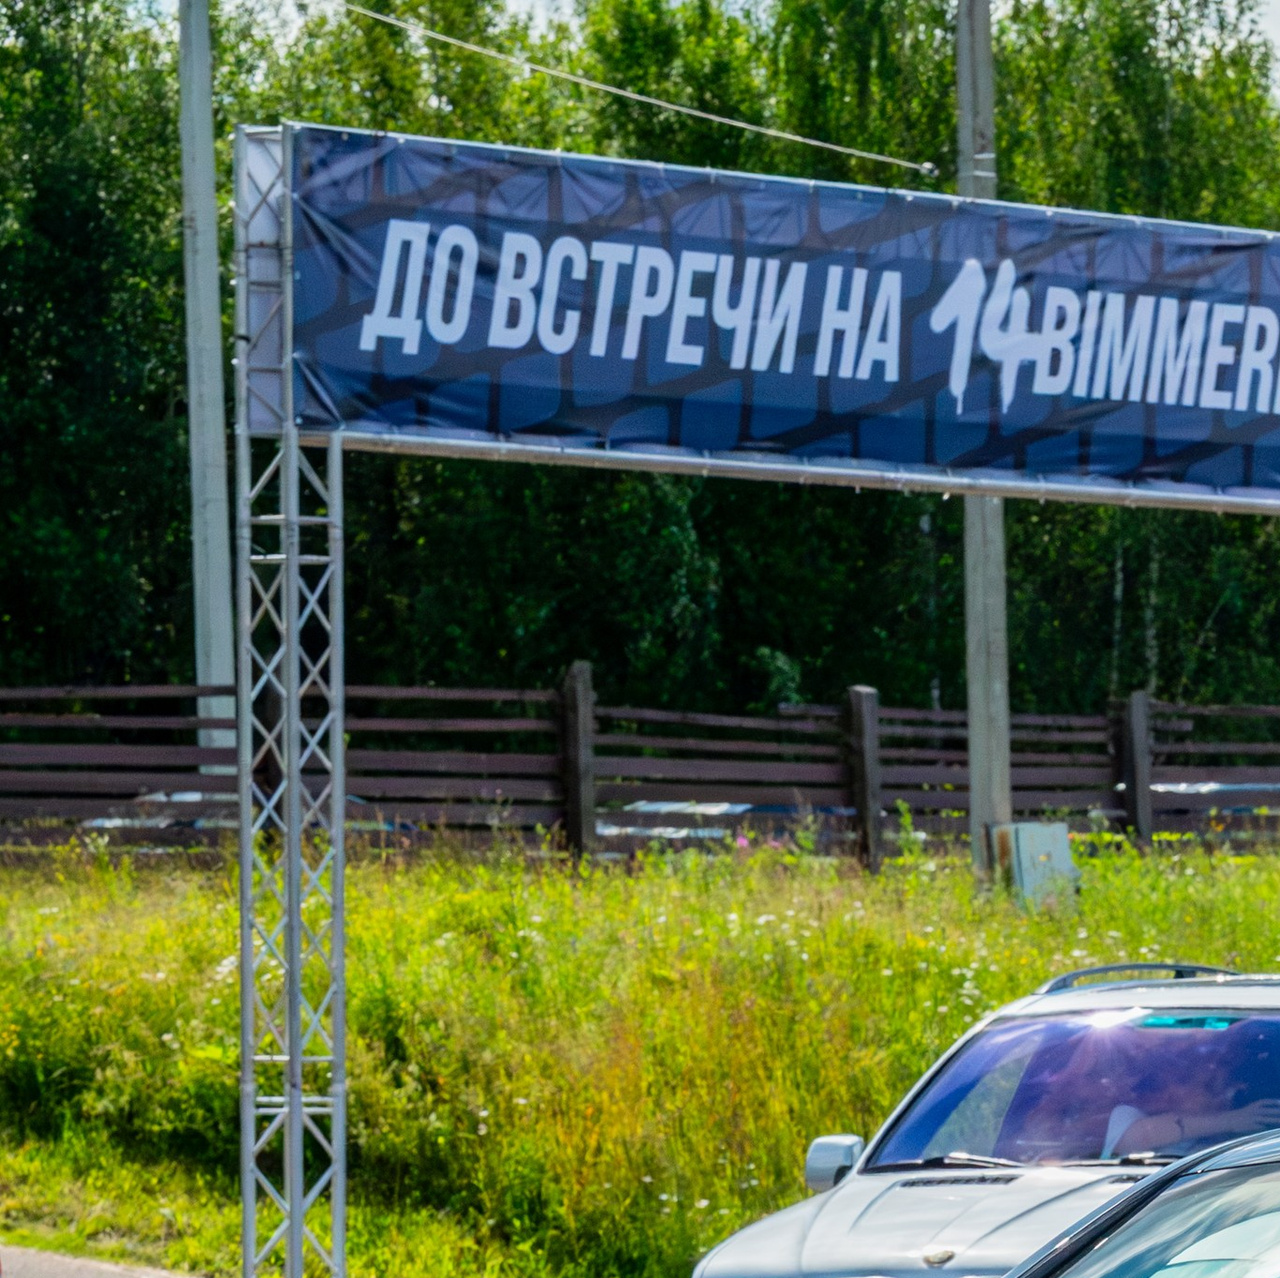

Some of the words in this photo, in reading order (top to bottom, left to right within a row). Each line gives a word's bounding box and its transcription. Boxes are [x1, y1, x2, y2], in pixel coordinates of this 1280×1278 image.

[359, 219, 479, 354] ДО
[487, 231, 808, 375] ВСТРЕЧИ
[813, 265, 902, 383] НА
